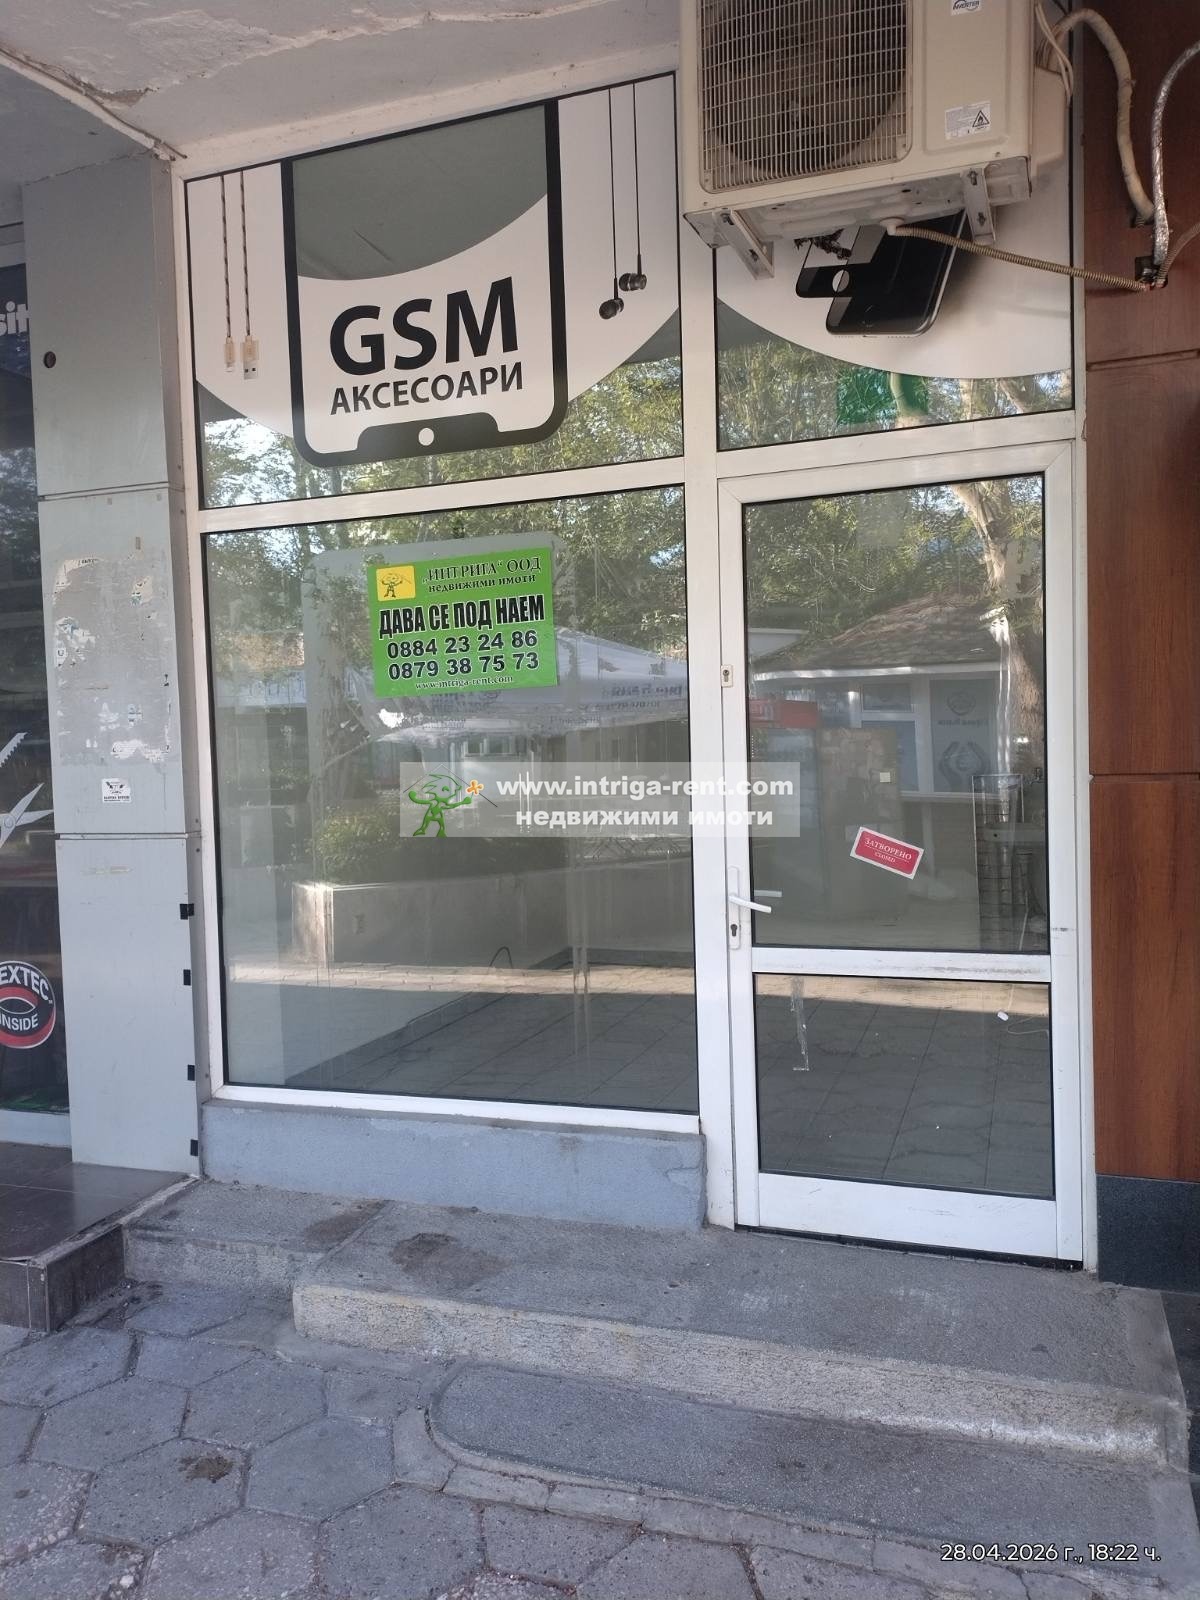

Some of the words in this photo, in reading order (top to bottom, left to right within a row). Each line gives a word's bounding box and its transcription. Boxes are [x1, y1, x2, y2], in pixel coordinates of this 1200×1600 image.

[330, 276, 518, 376] GSM
[330, 361, 523, 415] АКСЕСОАРИ
[506, 557, 541, 573] ООД
[428, 579, 496, 593] недвижими
[498, 575, 536, 587] имоти
[379, 606, 425, 639] ДАВА
[428, 604, 450, 631] СЕ
[453, 600, 492, 630] ПОД
[495, 594, 545, 625] НАЕМ
[387, 638, 437, 659] 0884
[445, 635, 470, 654] 23
[477, 632, 504, 651] 24
[511, 630, 537, 648] 86
[388, 660, 439, 680] 0879
[446, 657, 472, 676] 38
[479, 655, 505, 673] 75
[512, 652, 539, 670] 73
[415, 676, 513, 690] www.intriga-rent.com
[864, 837, 912, 860] ЗАТВОРЕНО
[0, 1012, 39, 1031] NSIDE
